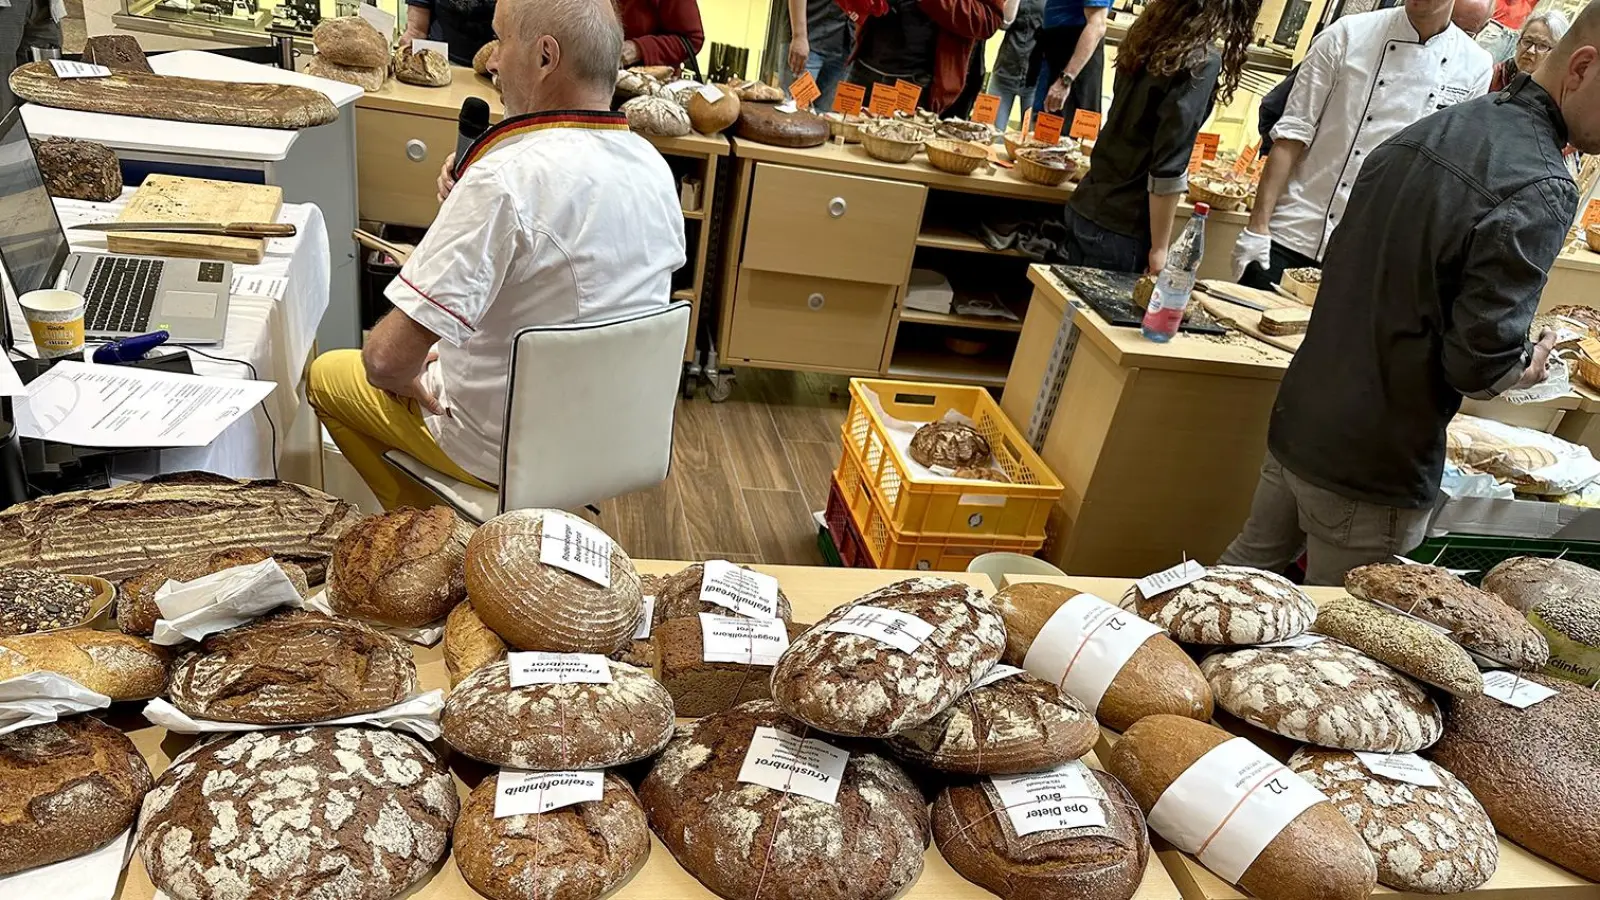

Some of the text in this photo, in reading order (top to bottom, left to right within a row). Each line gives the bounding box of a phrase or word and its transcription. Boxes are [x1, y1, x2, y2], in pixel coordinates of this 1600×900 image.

[1106, 617, 1126, 632] 22
[754, 757, 829, 782] Krustenbrot
[505, 779, 594, 794] Steinofenlaib
[1264, 778, 1288, 795] 22
[1035, 792, 1061, 804] Brot
[1025, 802, 1088, 820] Opa Dieter
